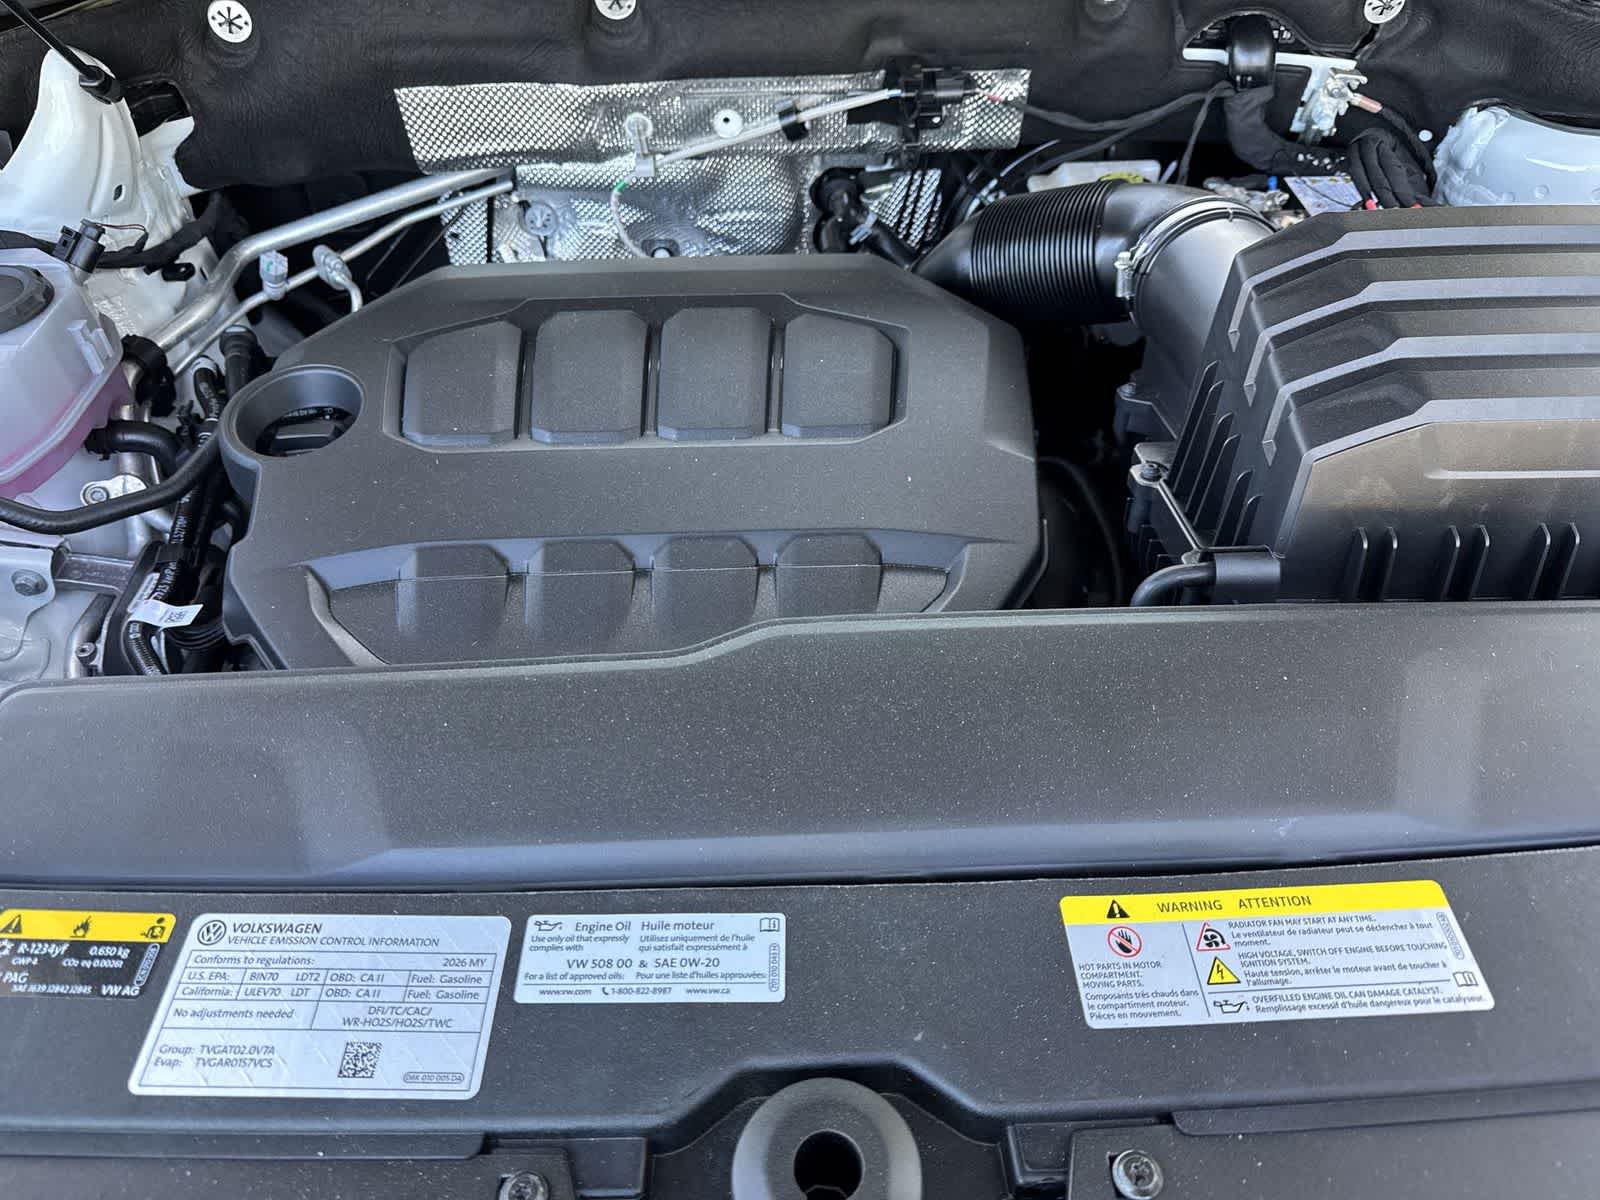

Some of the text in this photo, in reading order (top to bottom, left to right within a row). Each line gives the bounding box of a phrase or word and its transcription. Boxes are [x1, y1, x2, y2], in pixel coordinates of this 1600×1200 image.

[1157, 896, 1312, 913] WARNING ATTENTION
[232, 923, 322, 933] VOLKSWAGEN
[575, 921, 631, 934] Engine Oil
[641, 921, 714, 930] Huile moteur
[1242, 930, 1284, 938] ventilateur
[1336, 926, 1354, 934] peut
[227, 936, 439, 946] VEHICLE EMISSION CONTROL INFORMATION
[546, 936, 564, 944] only
[594, 935, 630, 944] expressly
[670, 936, 718, 944] uniquement
[732, 934, 756, 942] l'huile
[1234, 939, 1270, 947] moment.
[17, 943, 69, 957] R-1234yf
[118, 946, 130, 958] kg
[686, 944, 740, 952] expressément
[1296, 948, 1326, 956] SWITCH
[1376, 944, 1406, 952] BEFORE
[194, 955, 486, 966] Conforms to regulations: 2026 MY
[567, 958, 720, 968] VW 508 00 & SAE 0W-20
[1240, 960, 1278, 968] IGNITION
[1122, 962, 1131, 970] IN
[1133, 962, 1161, 970] MOTOR
[1304, 966, 1331, 974] arrêter
[3, 972, 29, 983] PAG
[188, 972, 204, 980] U.S.
[208, 972, 229, 980] EPA:
[296, 973, 320, 981] LDT2
[330, 974, 356, 982] OBD:
[410, 974, 435, 983] Fuel:
[440, 974, 482, 984] Gasoline
[560, 972, 568, 980] of
[570, 973, 607, 982] approved
[636, 972, 654, 980] Pour
[1080, 971, 1143, 980] COMPARTMENT.
[101, 985, 140, 996] VW AG
[182, 988, 233, 996] California:
[244, 988, 281, 996] ULEV70
[290, 988, 310, 996] LDT
[325, 989, 351, 997] OBD:
[408, 990, 431, 998] Fuel:
[436, 991, 479, 999] Gasoline
[612, 987, 672, 995] 1-800-822-8987
[1252, 994, 1301, 1003] OVERFILLED
[1302, 992, 1332, 1000] ENGINE
[1349, 990, 1366, 998] CAN
[1367, 988, 1401, 997] DAMAGE
[1086, 992, 1134, 1002] Composants
[1135, 991, 1150, 999] très
[1151, 990, 1178, 998] chauds
[1096, 1001, 1156, 1012] compartiment
[1159, 1000, 1190, 1008] moteur.
[1256, 1004, 1307, 1014] Remplissage
[1308, 1002, 1340, 1010] excessif
[1370, 1000, 1411, 1008] dangereux
[1414, 998, 1432, 1006] pour
[1432, 996, 1440, 1004] le
[173, 1009, 294, 1020] No adjustments needed
[368, 1006, 432, 1016] DFI/TC/CAC/
[1090, 1010, 1114, 1020] Pièces
[1130, 1010, 1182, 1018] mouvement.
[159, 1045, 194, 1056] Group:
[154, 1058, 182, 1068] Evap:
